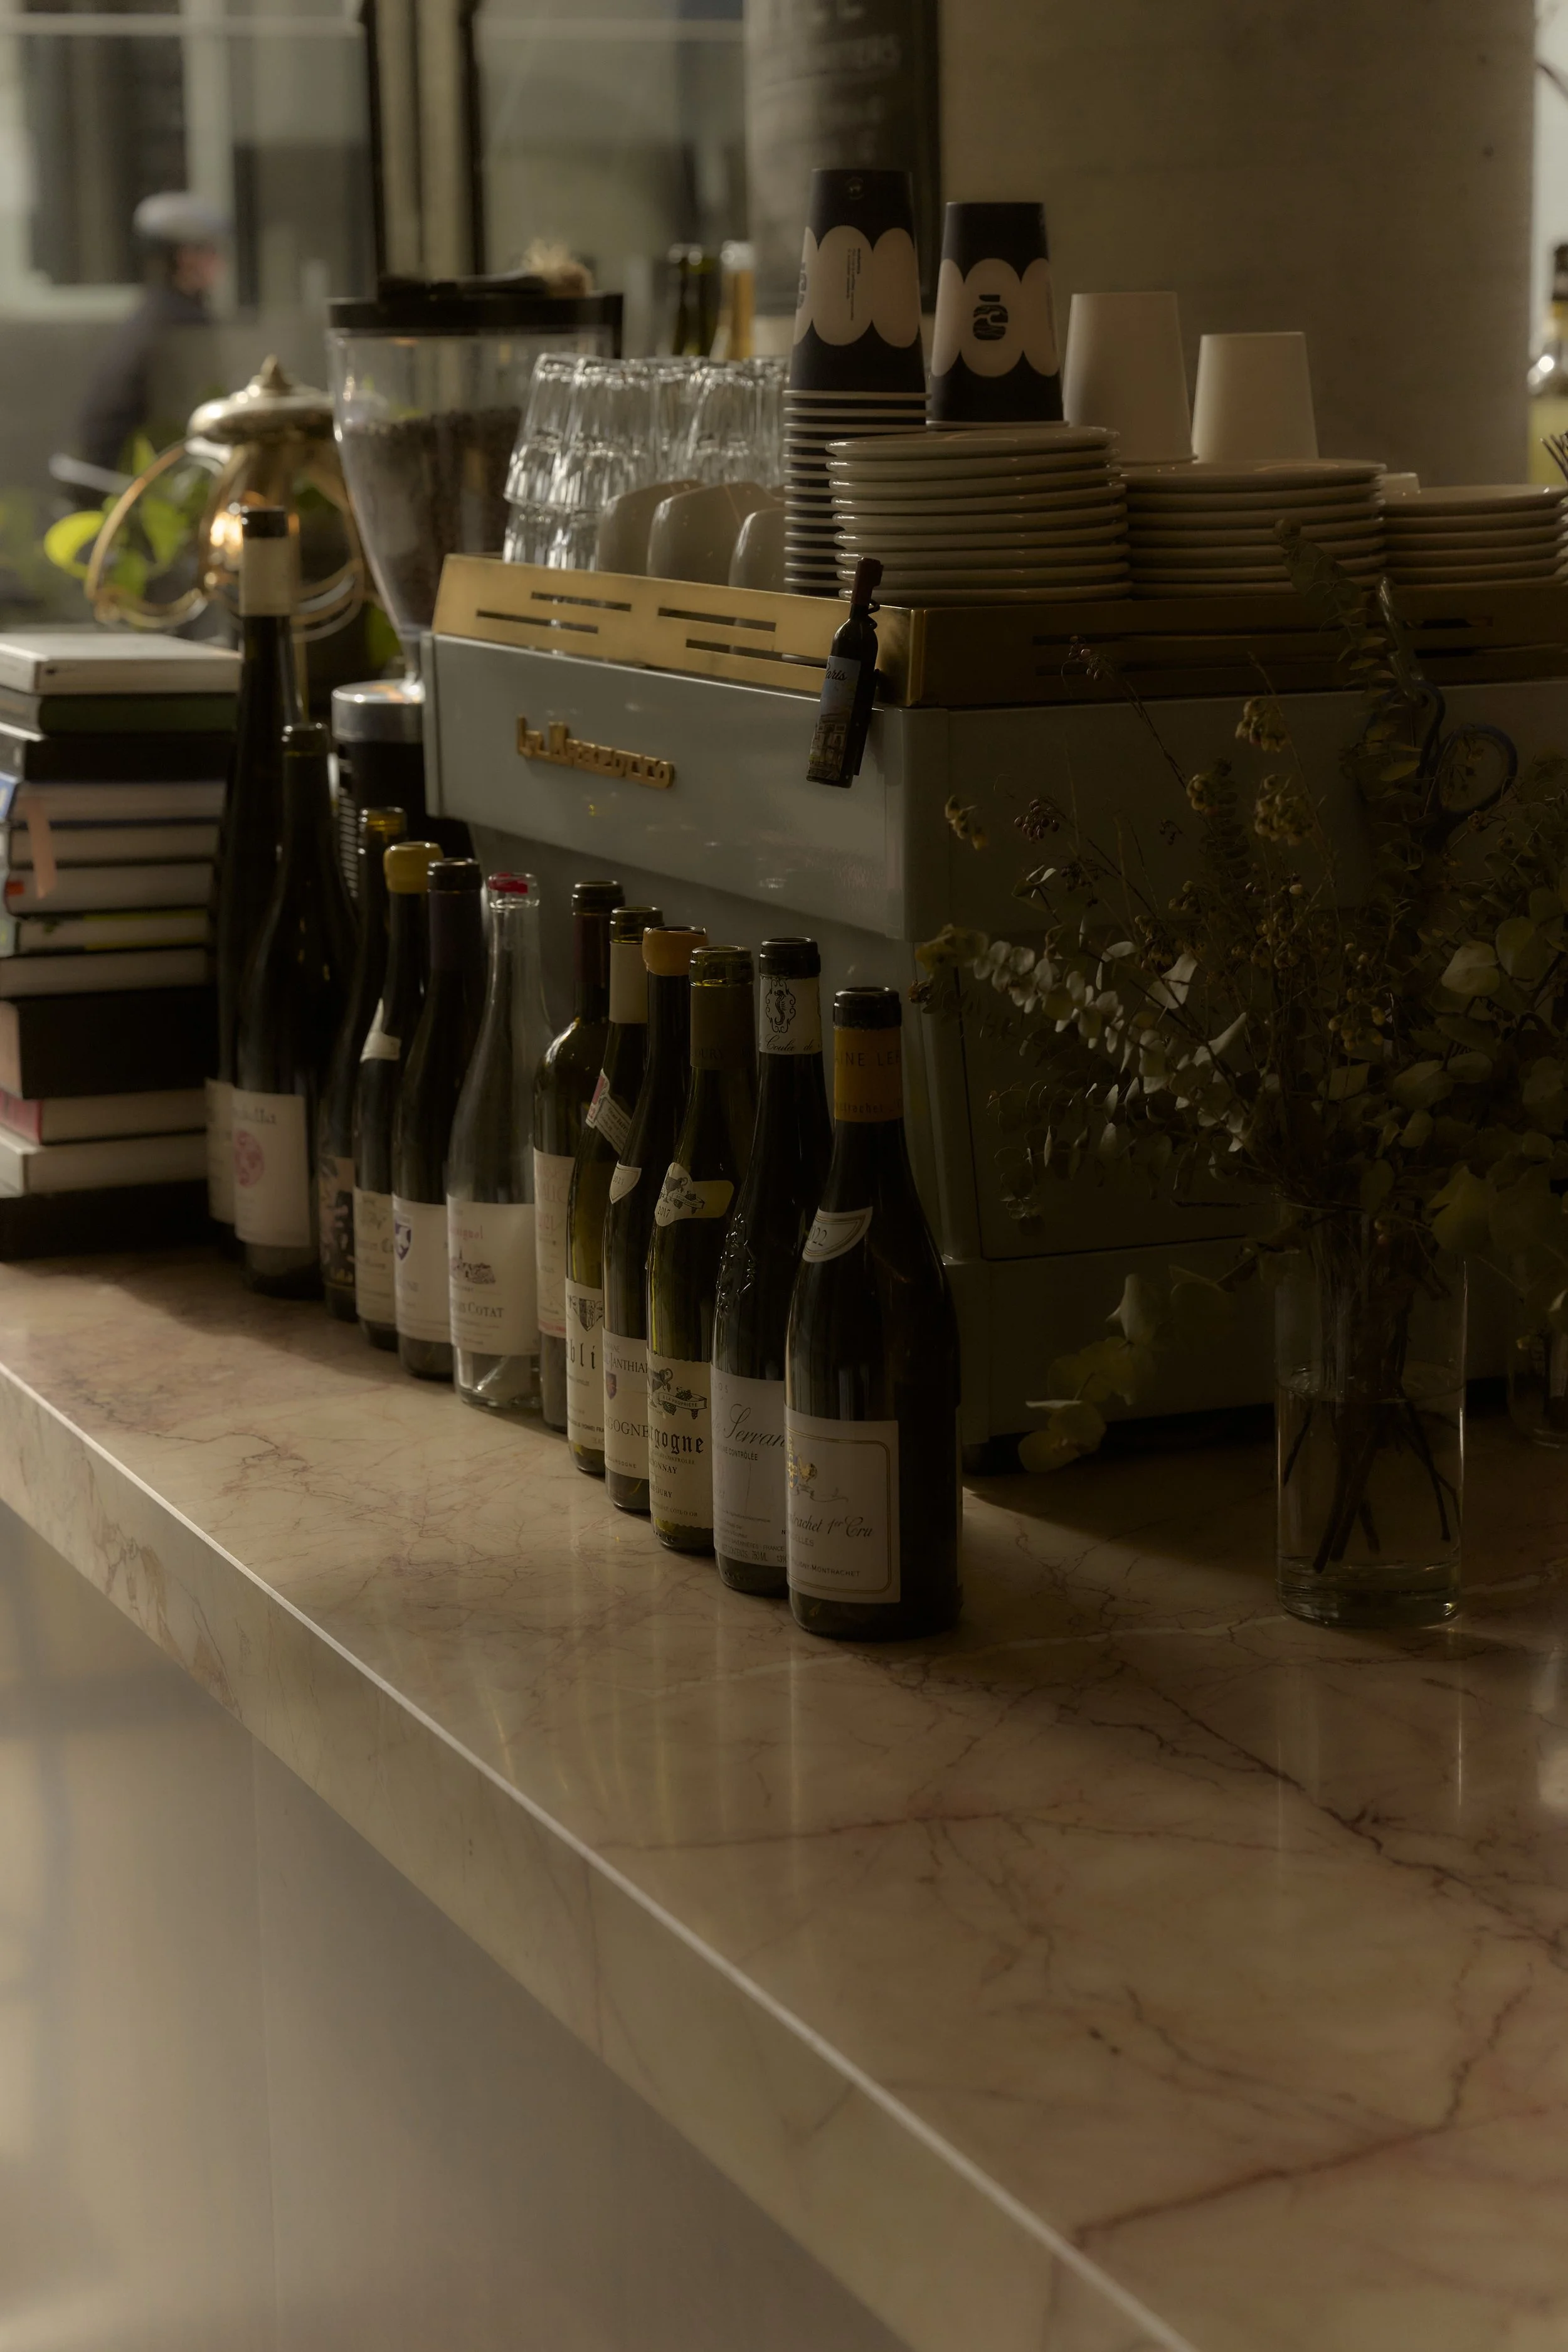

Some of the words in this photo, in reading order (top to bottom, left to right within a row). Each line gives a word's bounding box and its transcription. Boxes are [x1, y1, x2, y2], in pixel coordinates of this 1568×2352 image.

[657, 1205, 671, 1218] 2017
[568, 1338, 596, 1370] bli
[605, 1415, 648, 1439] GOGNE
[649, 1426, 704, 1454] rgogne
[791, 1512, 824, 1533] trachet
[844, 1515, 874, 1537] Cru
